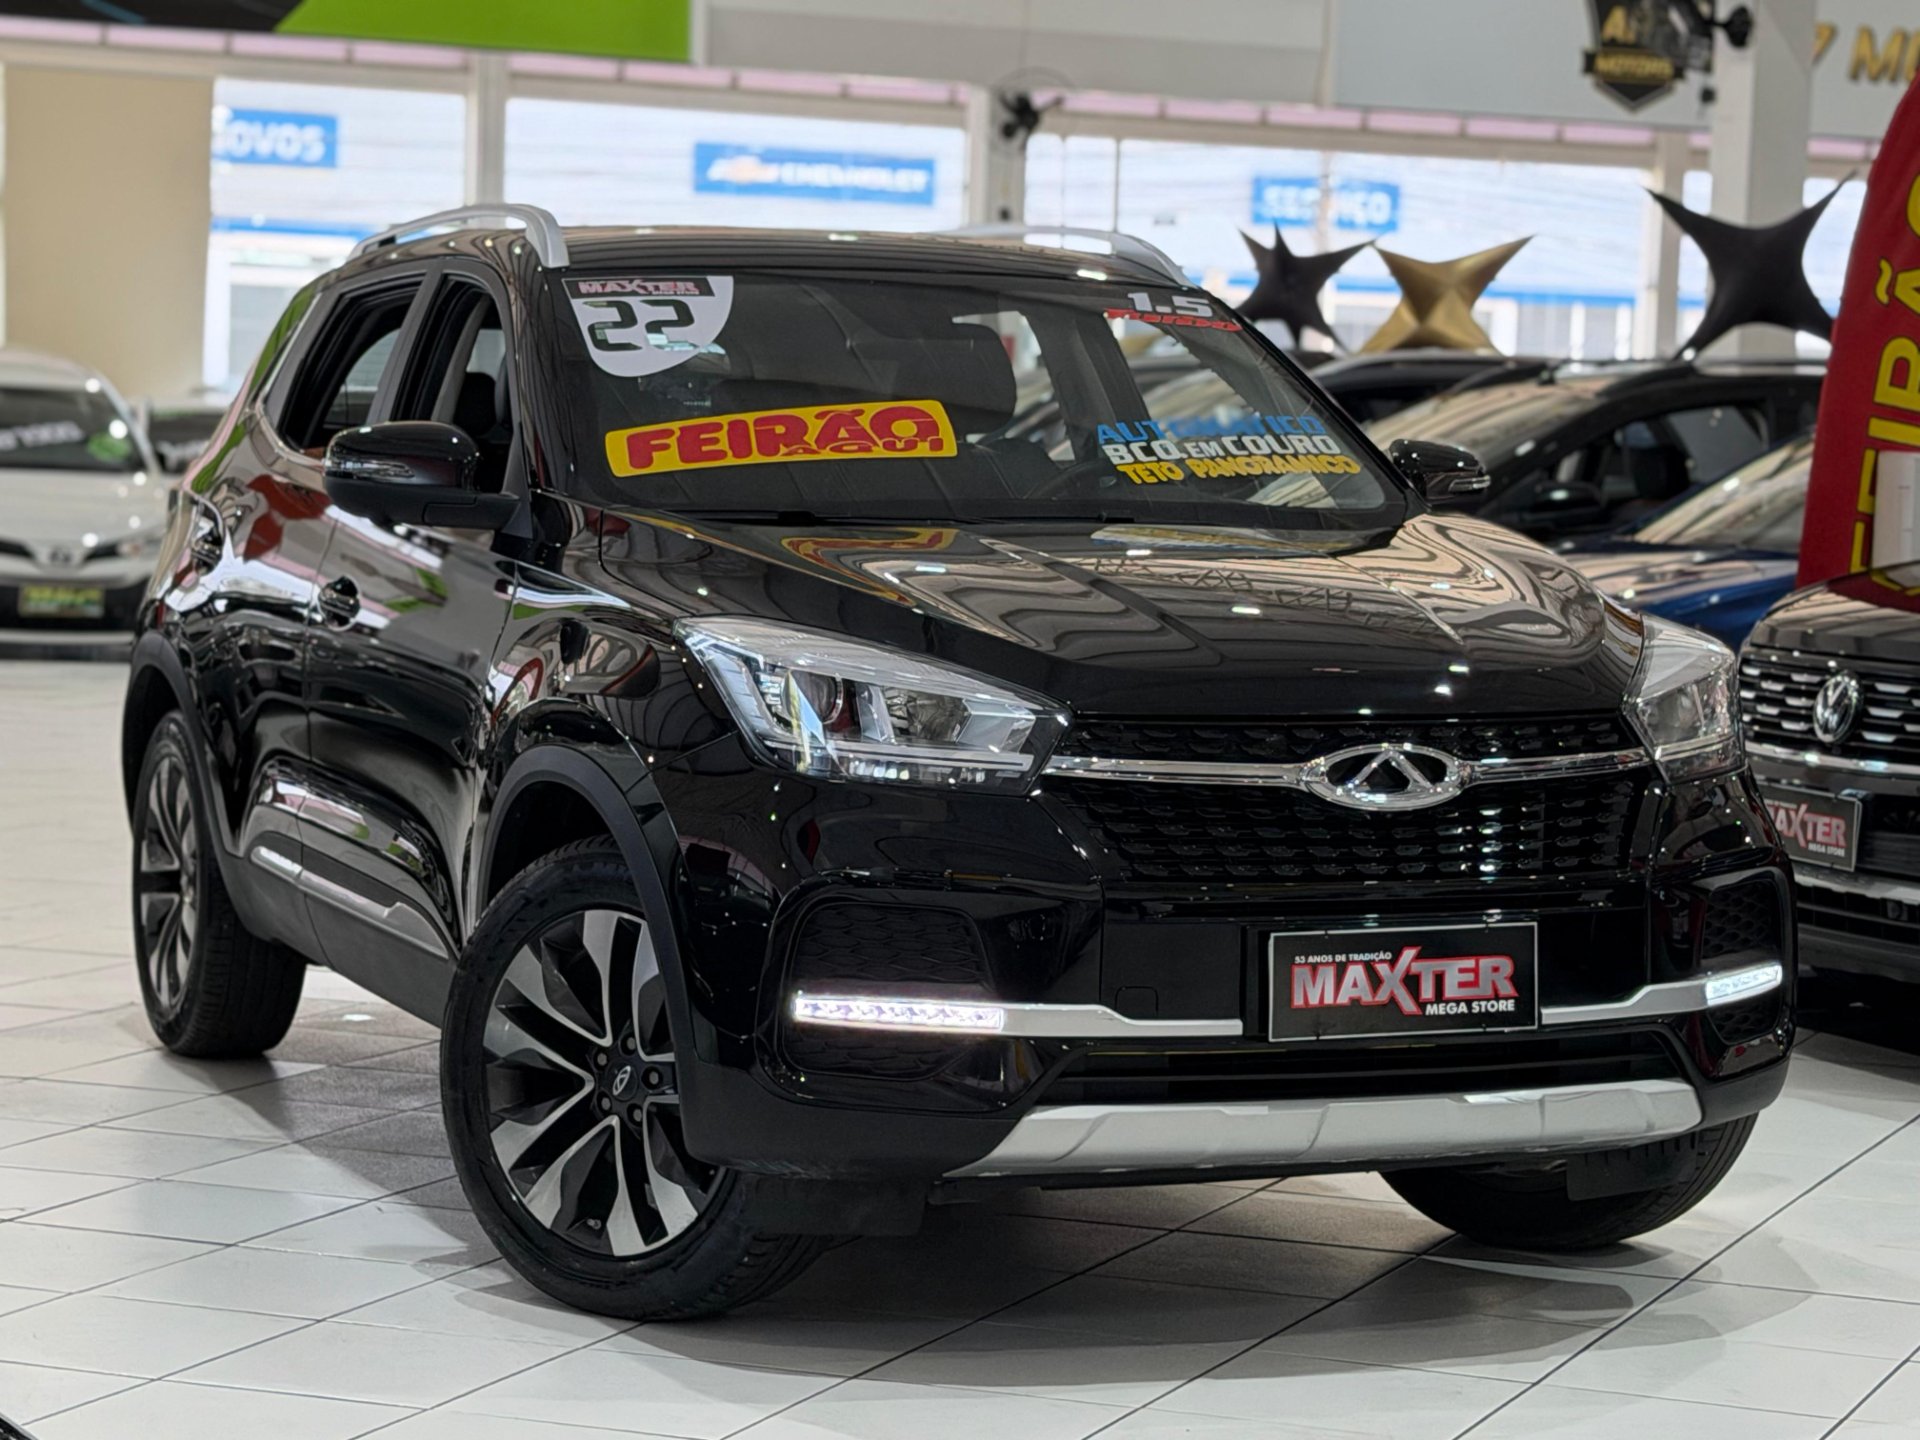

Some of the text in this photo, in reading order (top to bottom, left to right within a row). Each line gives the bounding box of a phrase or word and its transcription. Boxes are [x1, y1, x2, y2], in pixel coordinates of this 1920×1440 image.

[1127, 292, 1213, 318] 1.5
[582, 299, 700, 352] 22
[626, 406, 940, 469] FEIRÃO
[1184, 441, 1224, 459] EM
[1221, 435, 1342, 456] COURO
[1116, 461, 1186, 485] TETO
[1307, 954, 1333, 963] ANOS
[1335, 953, 1347, 962] DE
[1348, 949, 1393, 962] TRADIÇÃO
[1291, 946, 1519, 1015] MAXTER
[1425, 999, 1516, 1016] MEGA STORE
